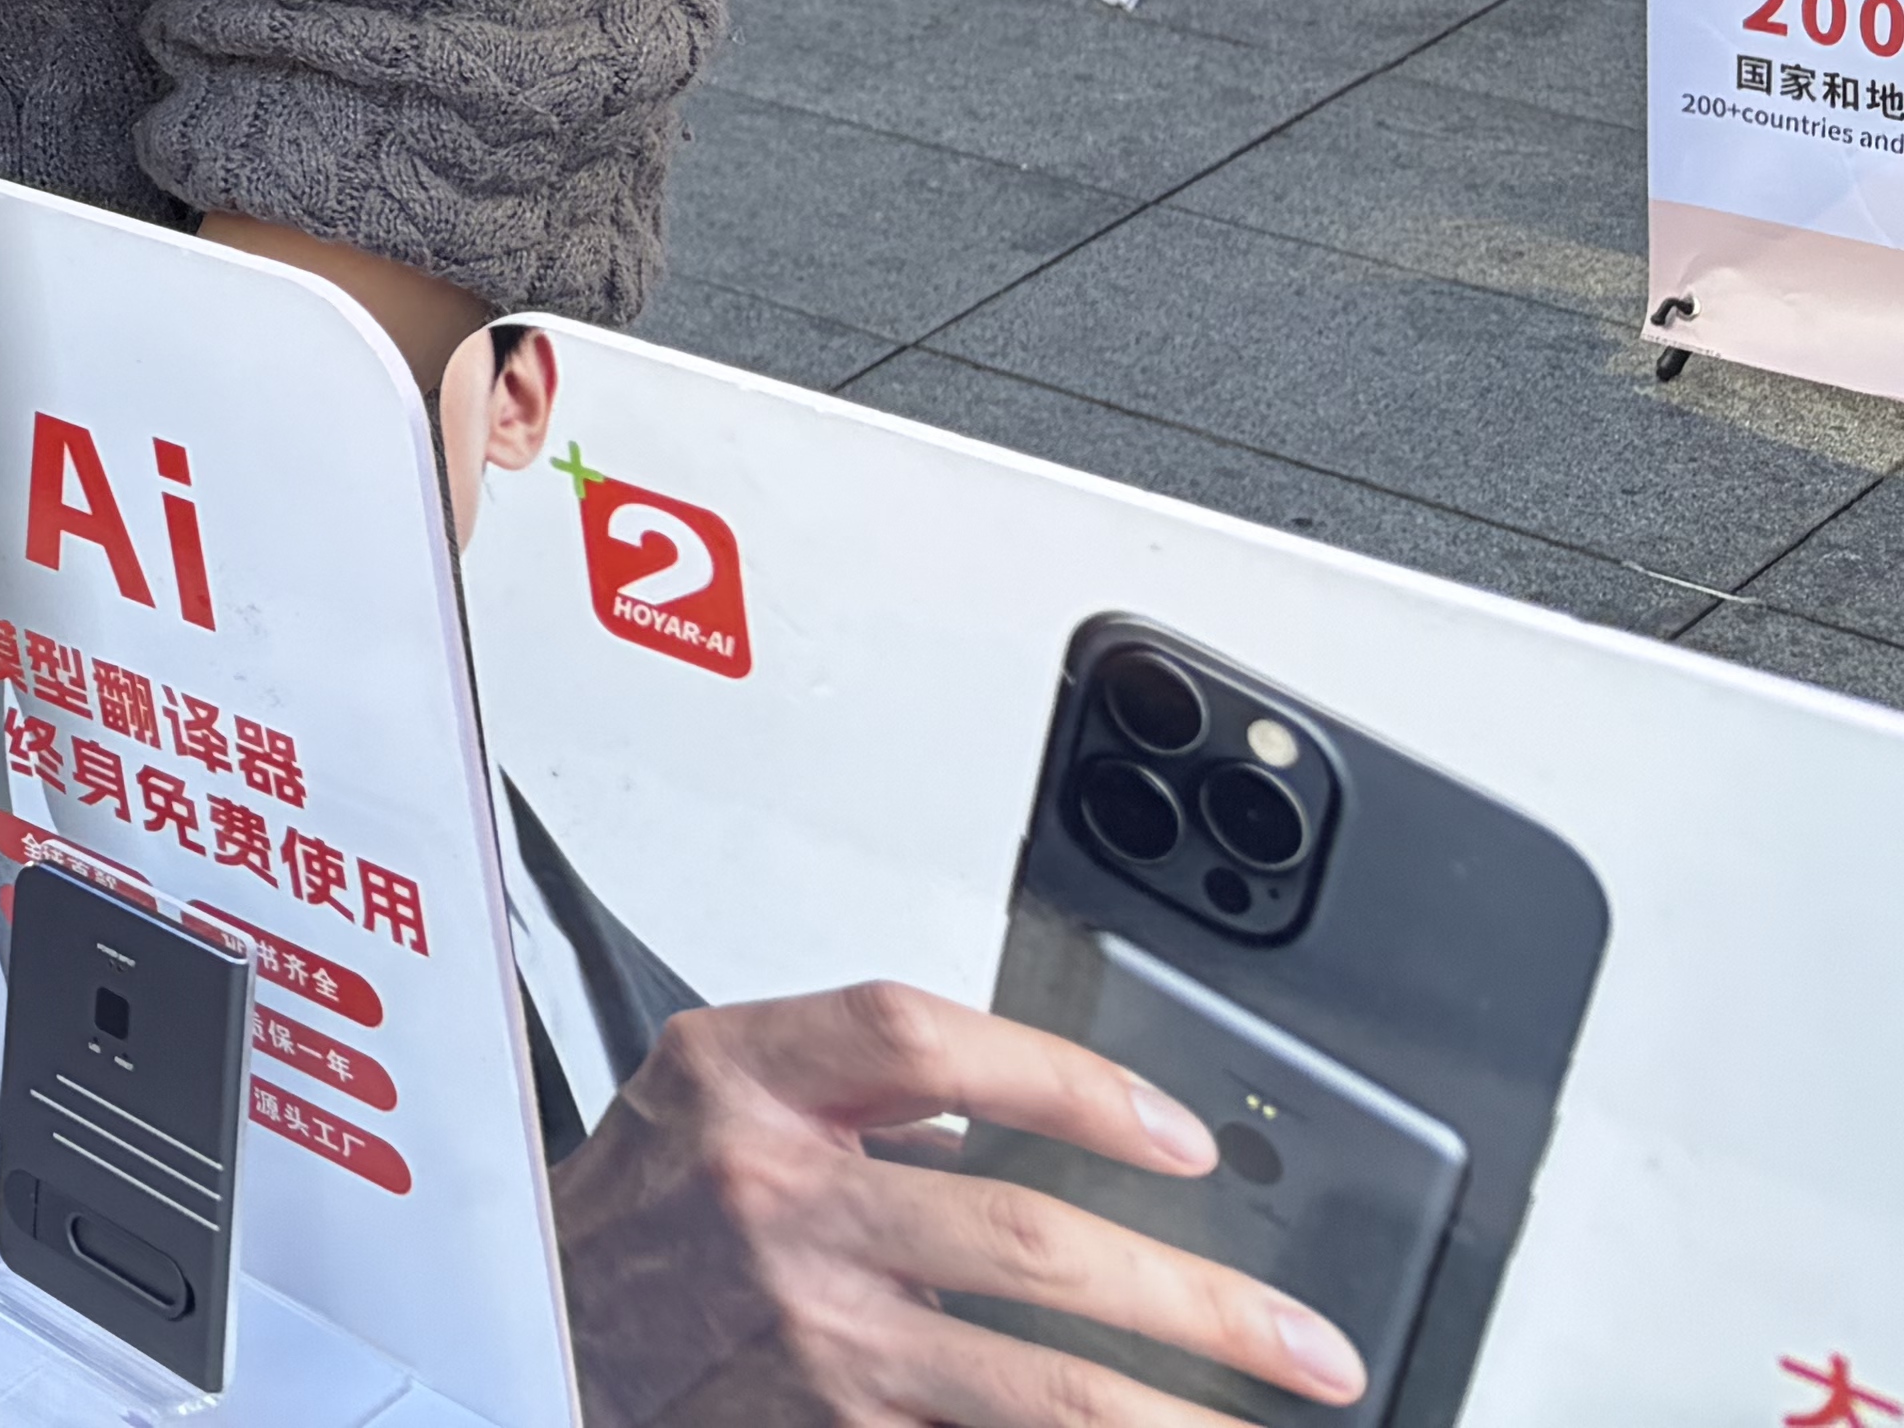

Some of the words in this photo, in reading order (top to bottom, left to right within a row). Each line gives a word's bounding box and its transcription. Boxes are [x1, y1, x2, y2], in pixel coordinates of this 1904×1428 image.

[1681, 92, 1854, 145] 200+countries
[1736, 54, 1904, 122] 国家和地
[24, 410, 217, 633] Ai
[607, 501, 716, 607] 2
[612, 595, 735, 658] HOYAR-AI
[3, 705, 431, 959] 终身免费使用
[254, 1085, 366, 1159] 源头工厂
